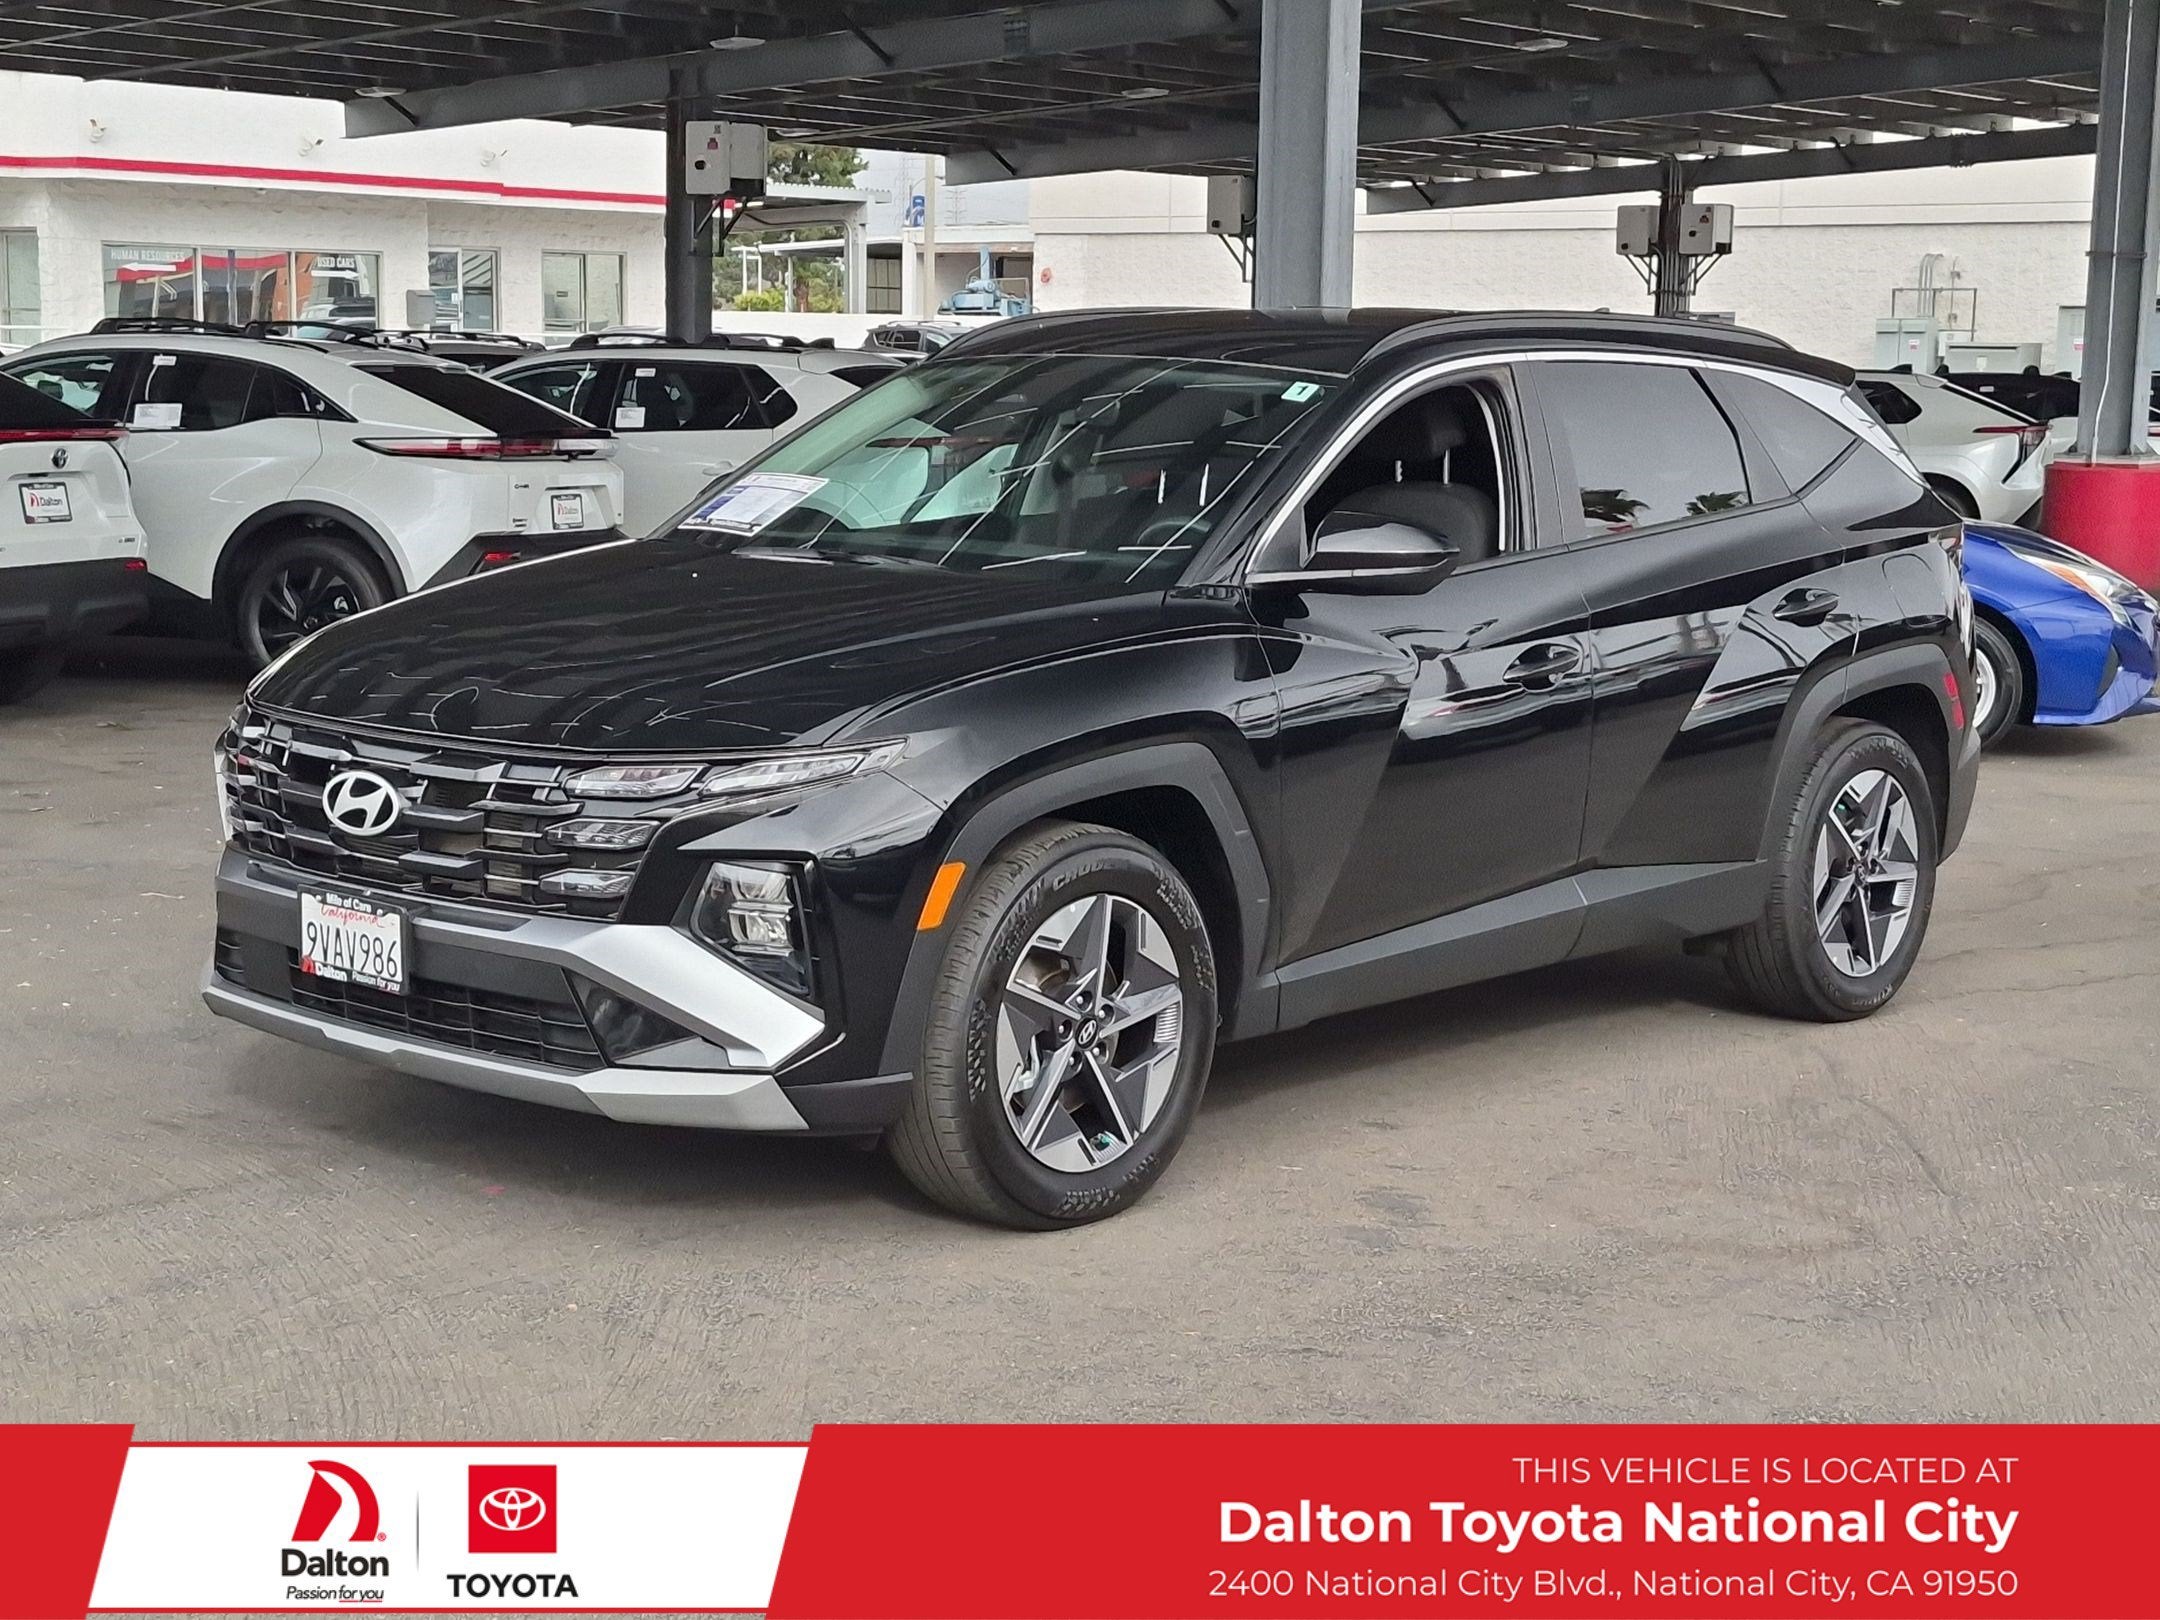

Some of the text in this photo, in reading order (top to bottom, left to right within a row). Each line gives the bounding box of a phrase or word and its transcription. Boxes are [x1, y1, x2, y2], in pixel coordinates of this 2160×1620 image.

[111, 248, 139, 260] HUMAN
[317, 256, 355, 268] USED CARS
[321, 903, 385, 928] California
[343, 898, 352, 908] of
[353, 899, 372, 913] Cars
[306, 921, 398, 978] 9VAV986
[315, 962, 348, 982] Dalton
[376, 976, 388, 989] for
[388, 981, 400, 992] you
